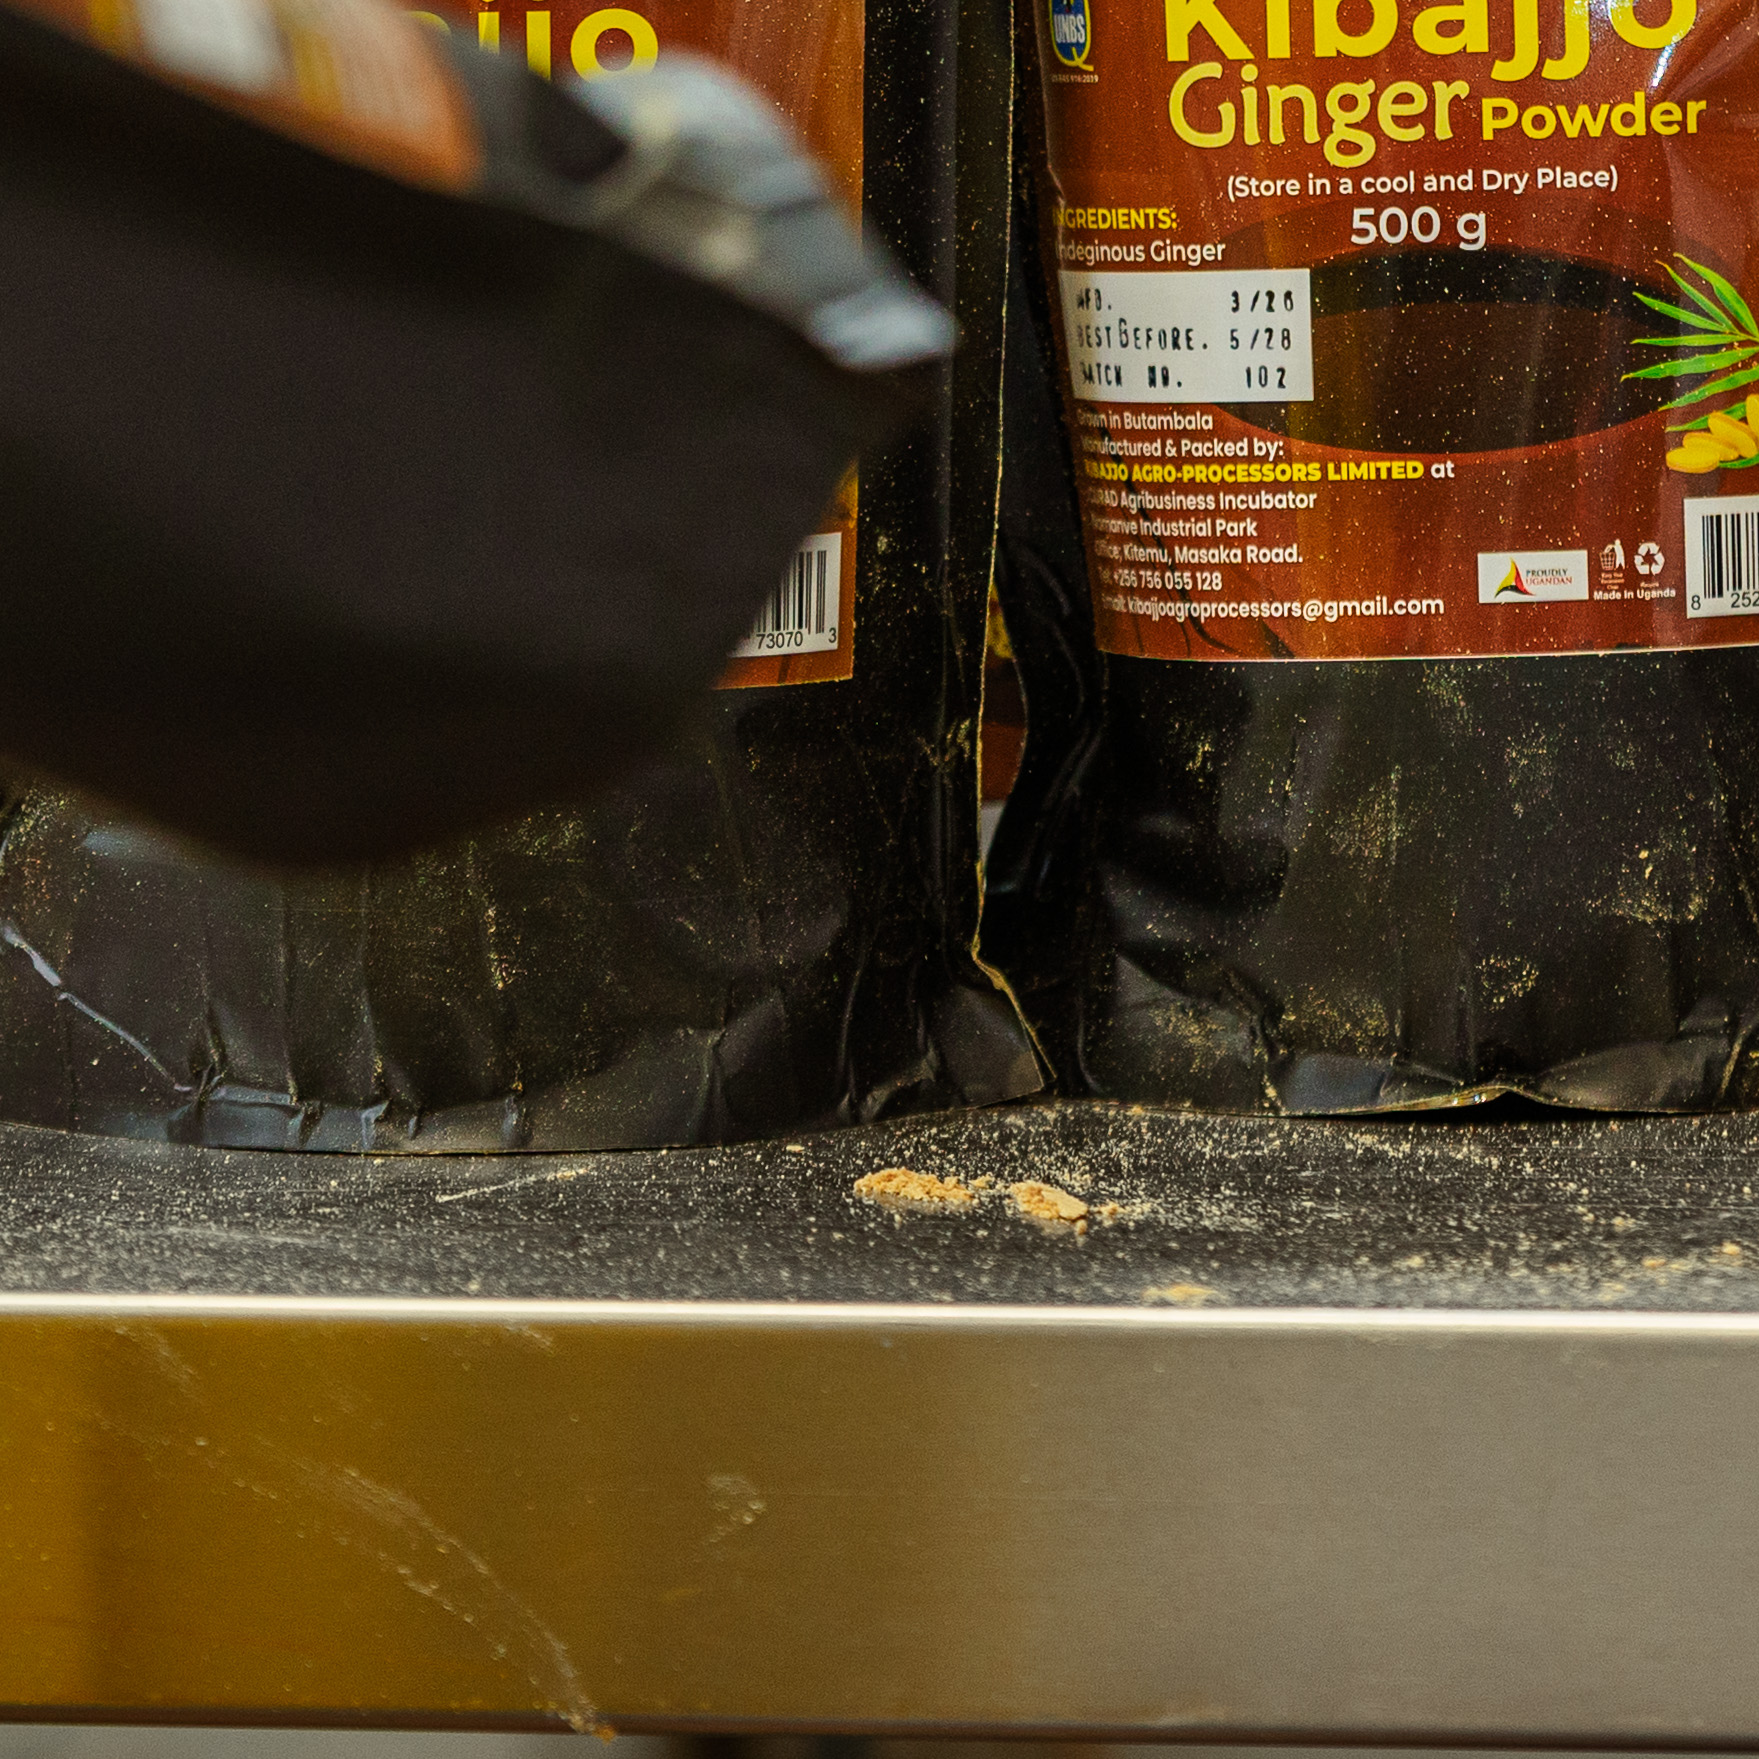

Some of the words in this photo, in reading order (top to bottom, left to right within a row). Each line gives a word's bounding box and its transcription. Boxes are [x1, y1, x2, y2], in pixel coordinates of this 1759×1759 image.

[1054, 13, 1086, 43] UNBS
[1168, 62, 1470, 168] Ginger
[1481, 91, 1708, 140] Powder
[1227, 176, 1300, 202] (Store
[1308, 174, 1331, 195] in
[1339, 179, 1353, 195] a
[1360, 171, 1415, 194] cool
[1423, 169, 1474, 193] and
[1482, 168, 1529, 195] Dry
[1537, 165, 1619, 192] Place)
[1351, 206, 1441, 243] 500
[1456, 212, 1486, 250] g
[1151, 239, 1226, 266] Ginger
[1246, 365, 1286, 389] 102
[1109, 410, 1121, 429] in
[1123, 412, 1214, 430] Butambala
[1165, 441, 1177, 457] &
[1181, 437, 1248, 457] Packed
[1254, 437, 1284, 461] by:
[1132, 462, 1322, 483] AGRO-PROCESSORS
[1327, 460, 1424, 481] LIMITED
[1430, 460, 1455, 479] at
[1121, 490, 1215, 514] Agribusiness
[1220, 490, 1317, 510] Incubator
[1140, 517, 1211, 537] Industrial
[1216, 517, 1258, 537] Park
[1124, 543, 1172, 566] Kitemu,
[1175, 545, 1242, 563] Masaka
[1246, 544, 1304, 564] Road.
[1139, 571, 1162, 589] 756
[1165, 572, 1192, 590] 055
[1196, 572, 1222, 591] 128
[1526, 568, 1568, 577] PROUDLY
[1526, 576, 1572, 586] UGANDAN
[1594, 590, 1621, 601] Made
[1637, 588, 1676, 601] Uganda
[1691, 595, 1701, 611] 8
[1128, 594, 1445, 624] kibajjoagroprocessors@gmail.com
[756, 631, 803, 649] 73070
[828, 627, 837, 643] 3
